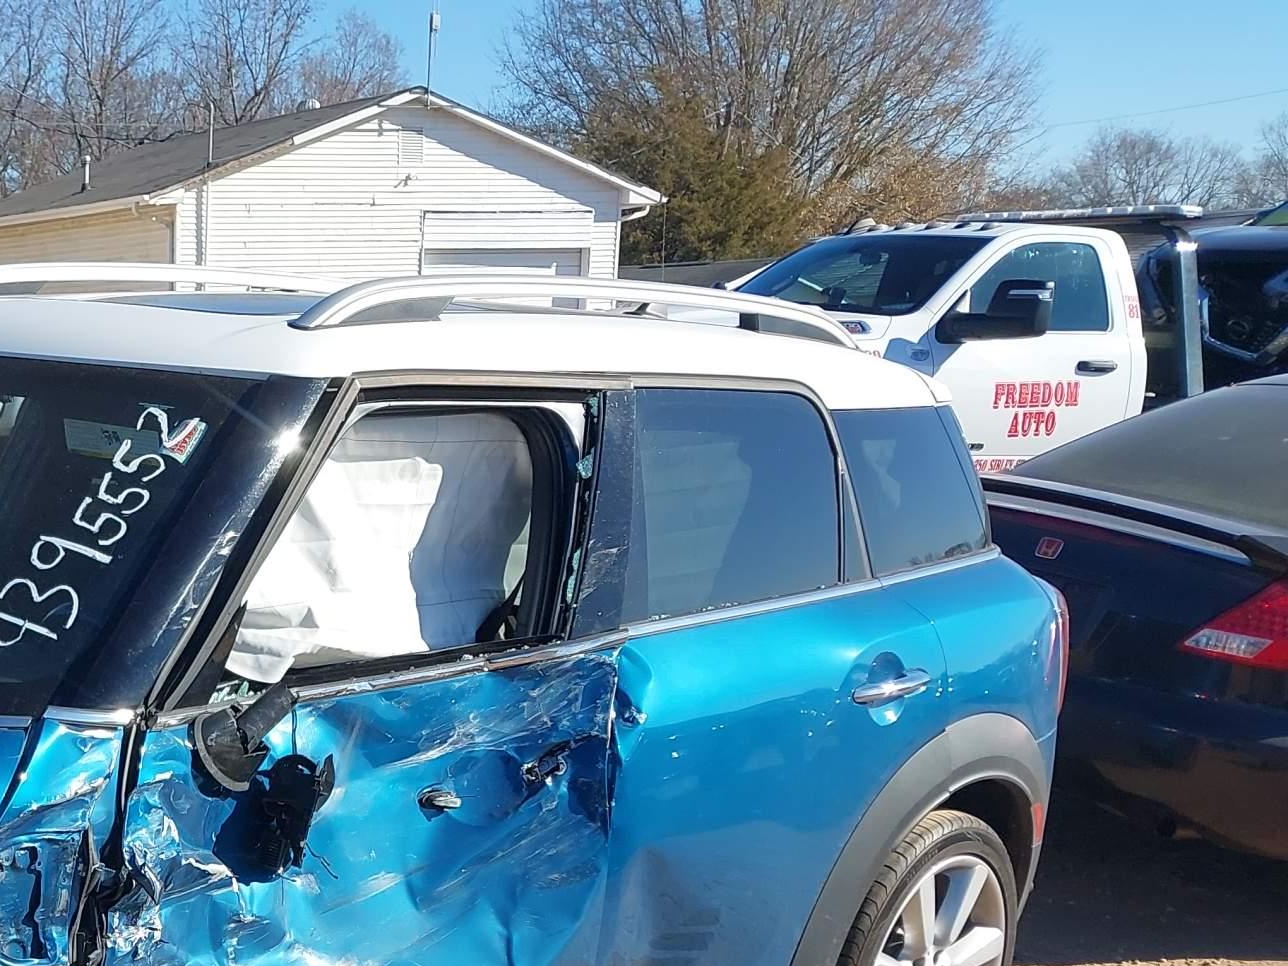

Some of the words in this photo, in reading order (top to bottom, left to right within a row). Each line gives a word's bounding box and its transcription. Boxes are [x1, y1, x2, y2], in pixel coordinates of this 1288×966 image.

[1128, 303, 1140, 319] 81
[992, 381, 1081, 409] FREEDOM
[1007, 410, 1056, 438] AUTO
